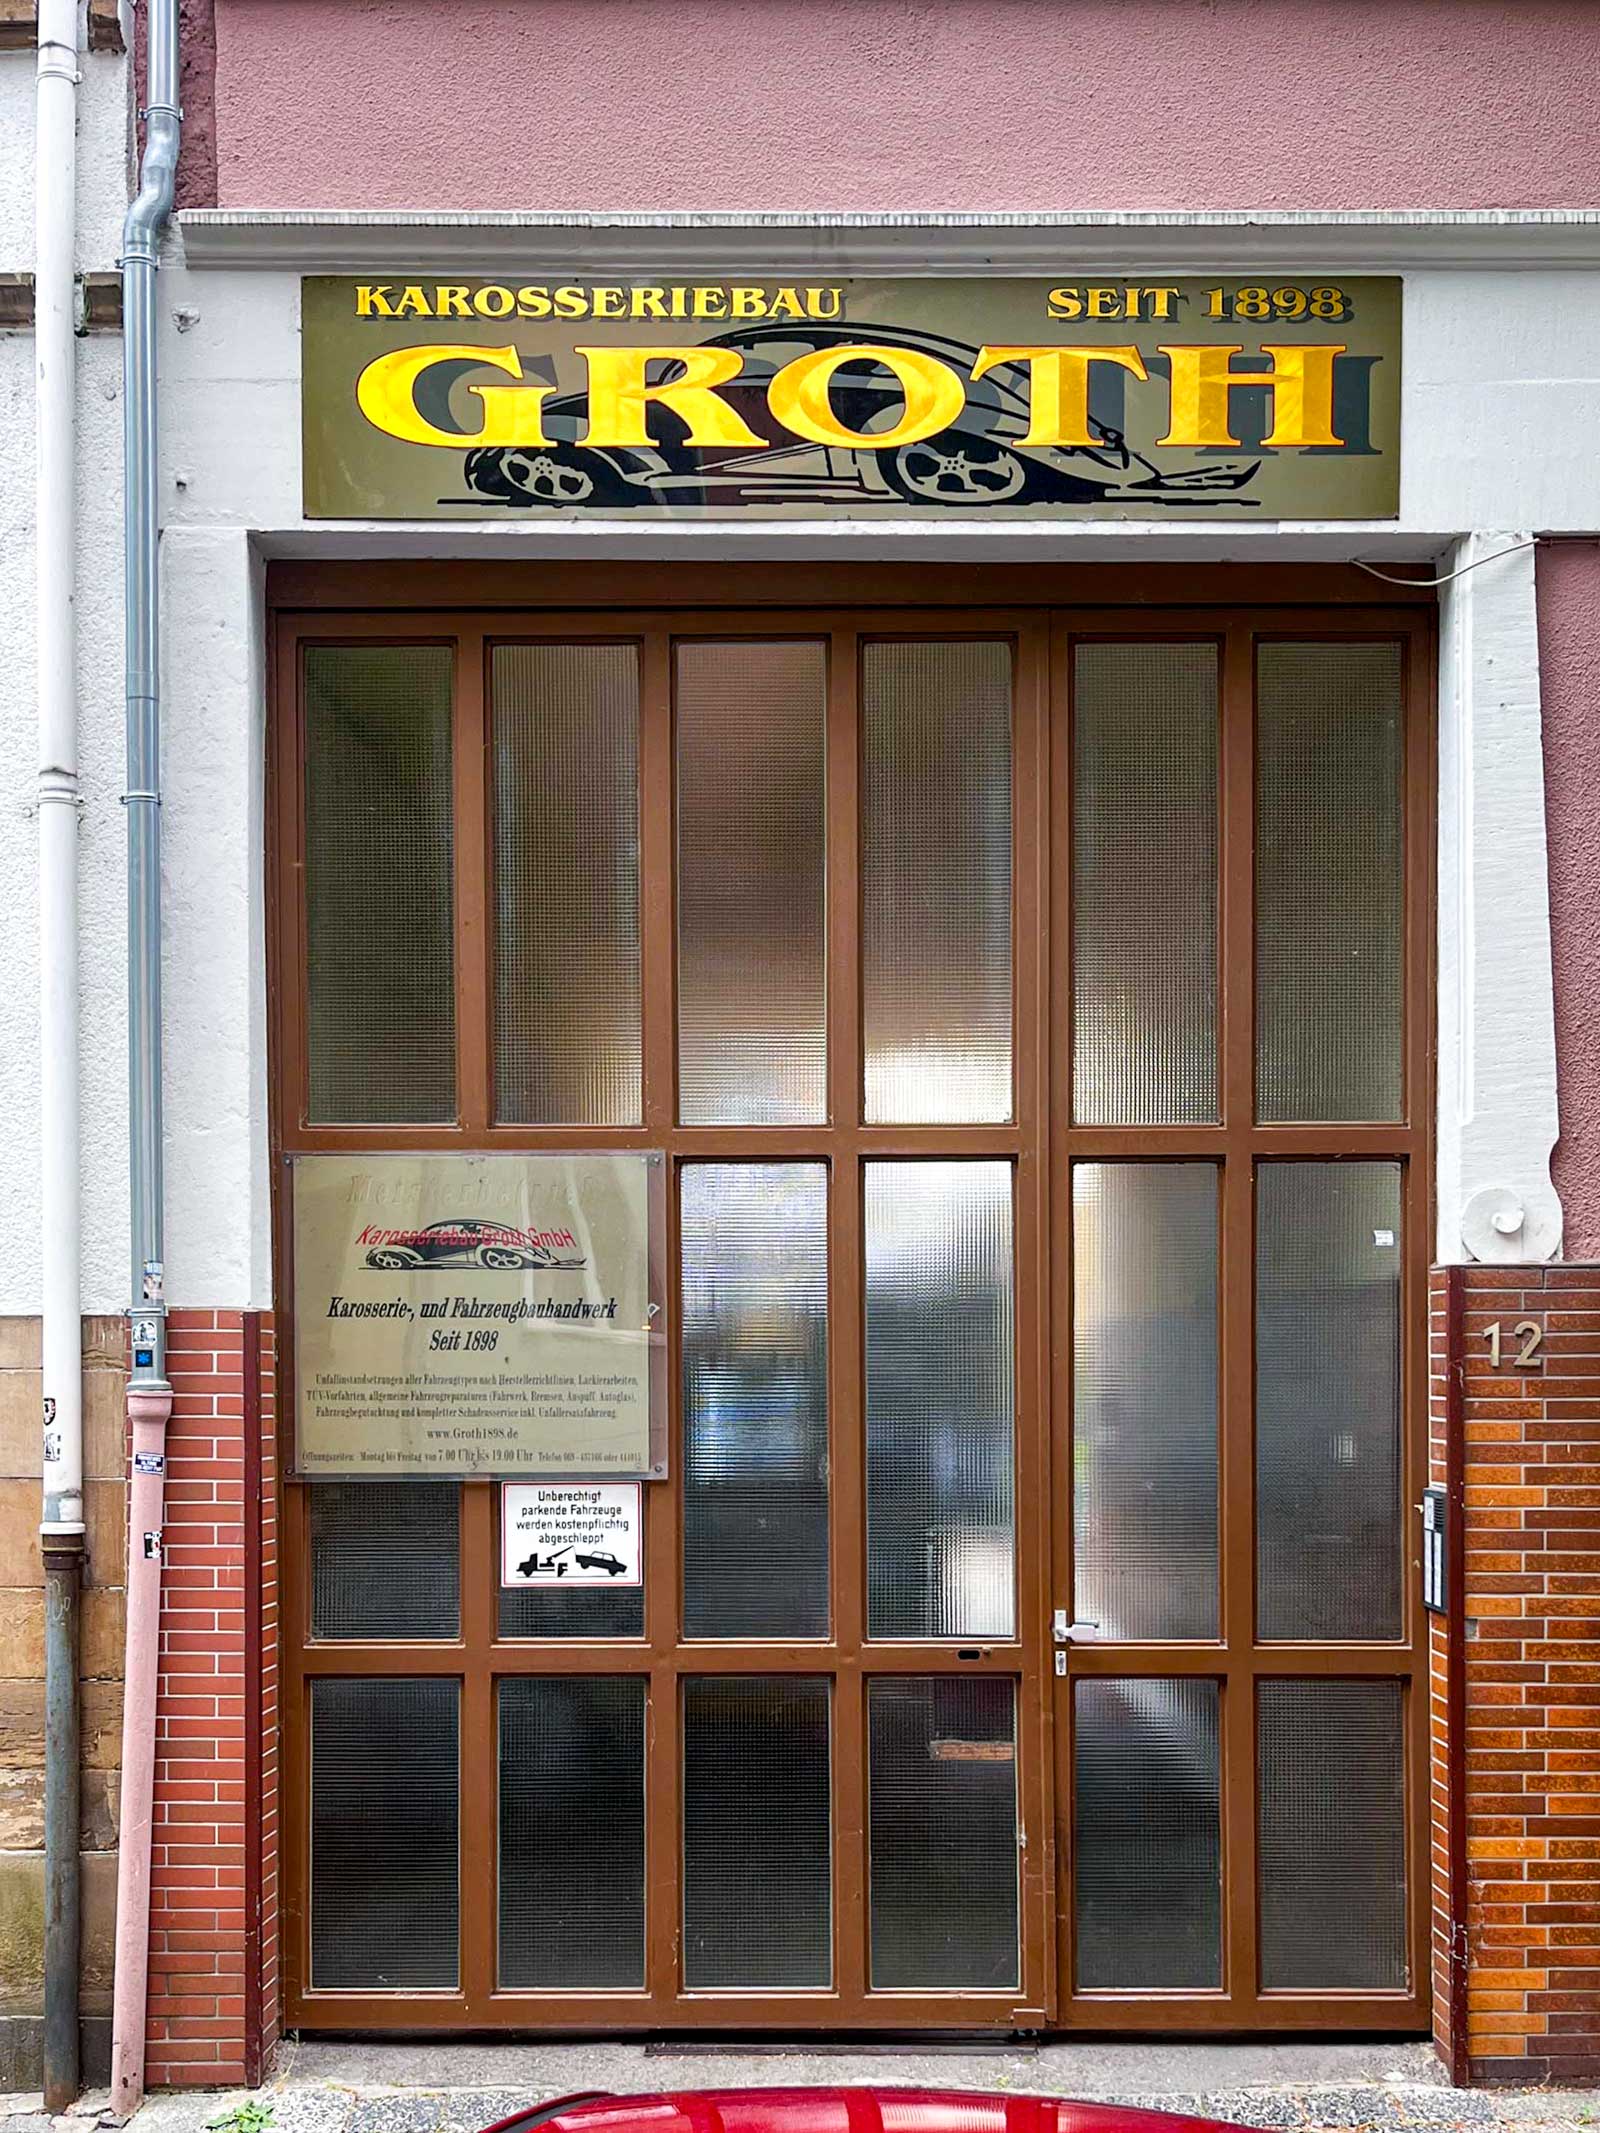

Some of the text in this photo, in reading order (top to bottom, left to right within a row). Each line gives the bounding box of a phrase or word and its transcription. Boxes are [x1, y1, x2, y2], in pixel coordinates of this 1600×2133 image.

[355, 285, 843, 319] KAROSSERIEBAU
[1047, 286, 1345, 319] SEIT 1898
[355, 344, 1347, 449] GROTH
[355, 1224, 577, 1248] Karosseriebau Groth GmbH
[326, 1297, 617, 1323] Karosserie-, und Fahrzeugbauhandwerk
[429, 1330, 499, 1351] Seit 1898
[1482, 1321, 1543, 1368] 12
[405, 1373, 422, 1385] aller
[424, 1373, 477, 1388] Fahrzeugtypen
[479, 1374, 496, 1385] nach
[401, 1407, 415, 1417] und
[427, 1427, 519, 1440] www.Groth1898.de
[517, 1449, 533, 1461] Uhr
[538, 1491, 601, 1503] Unberechtigt
[522, 1504, 622, 1517] parkende Fahrzeuge
[516, 1519, 629, 1531] werden kostenpflichtig
[539, 1533, 604, 1545] abgeschleppt
